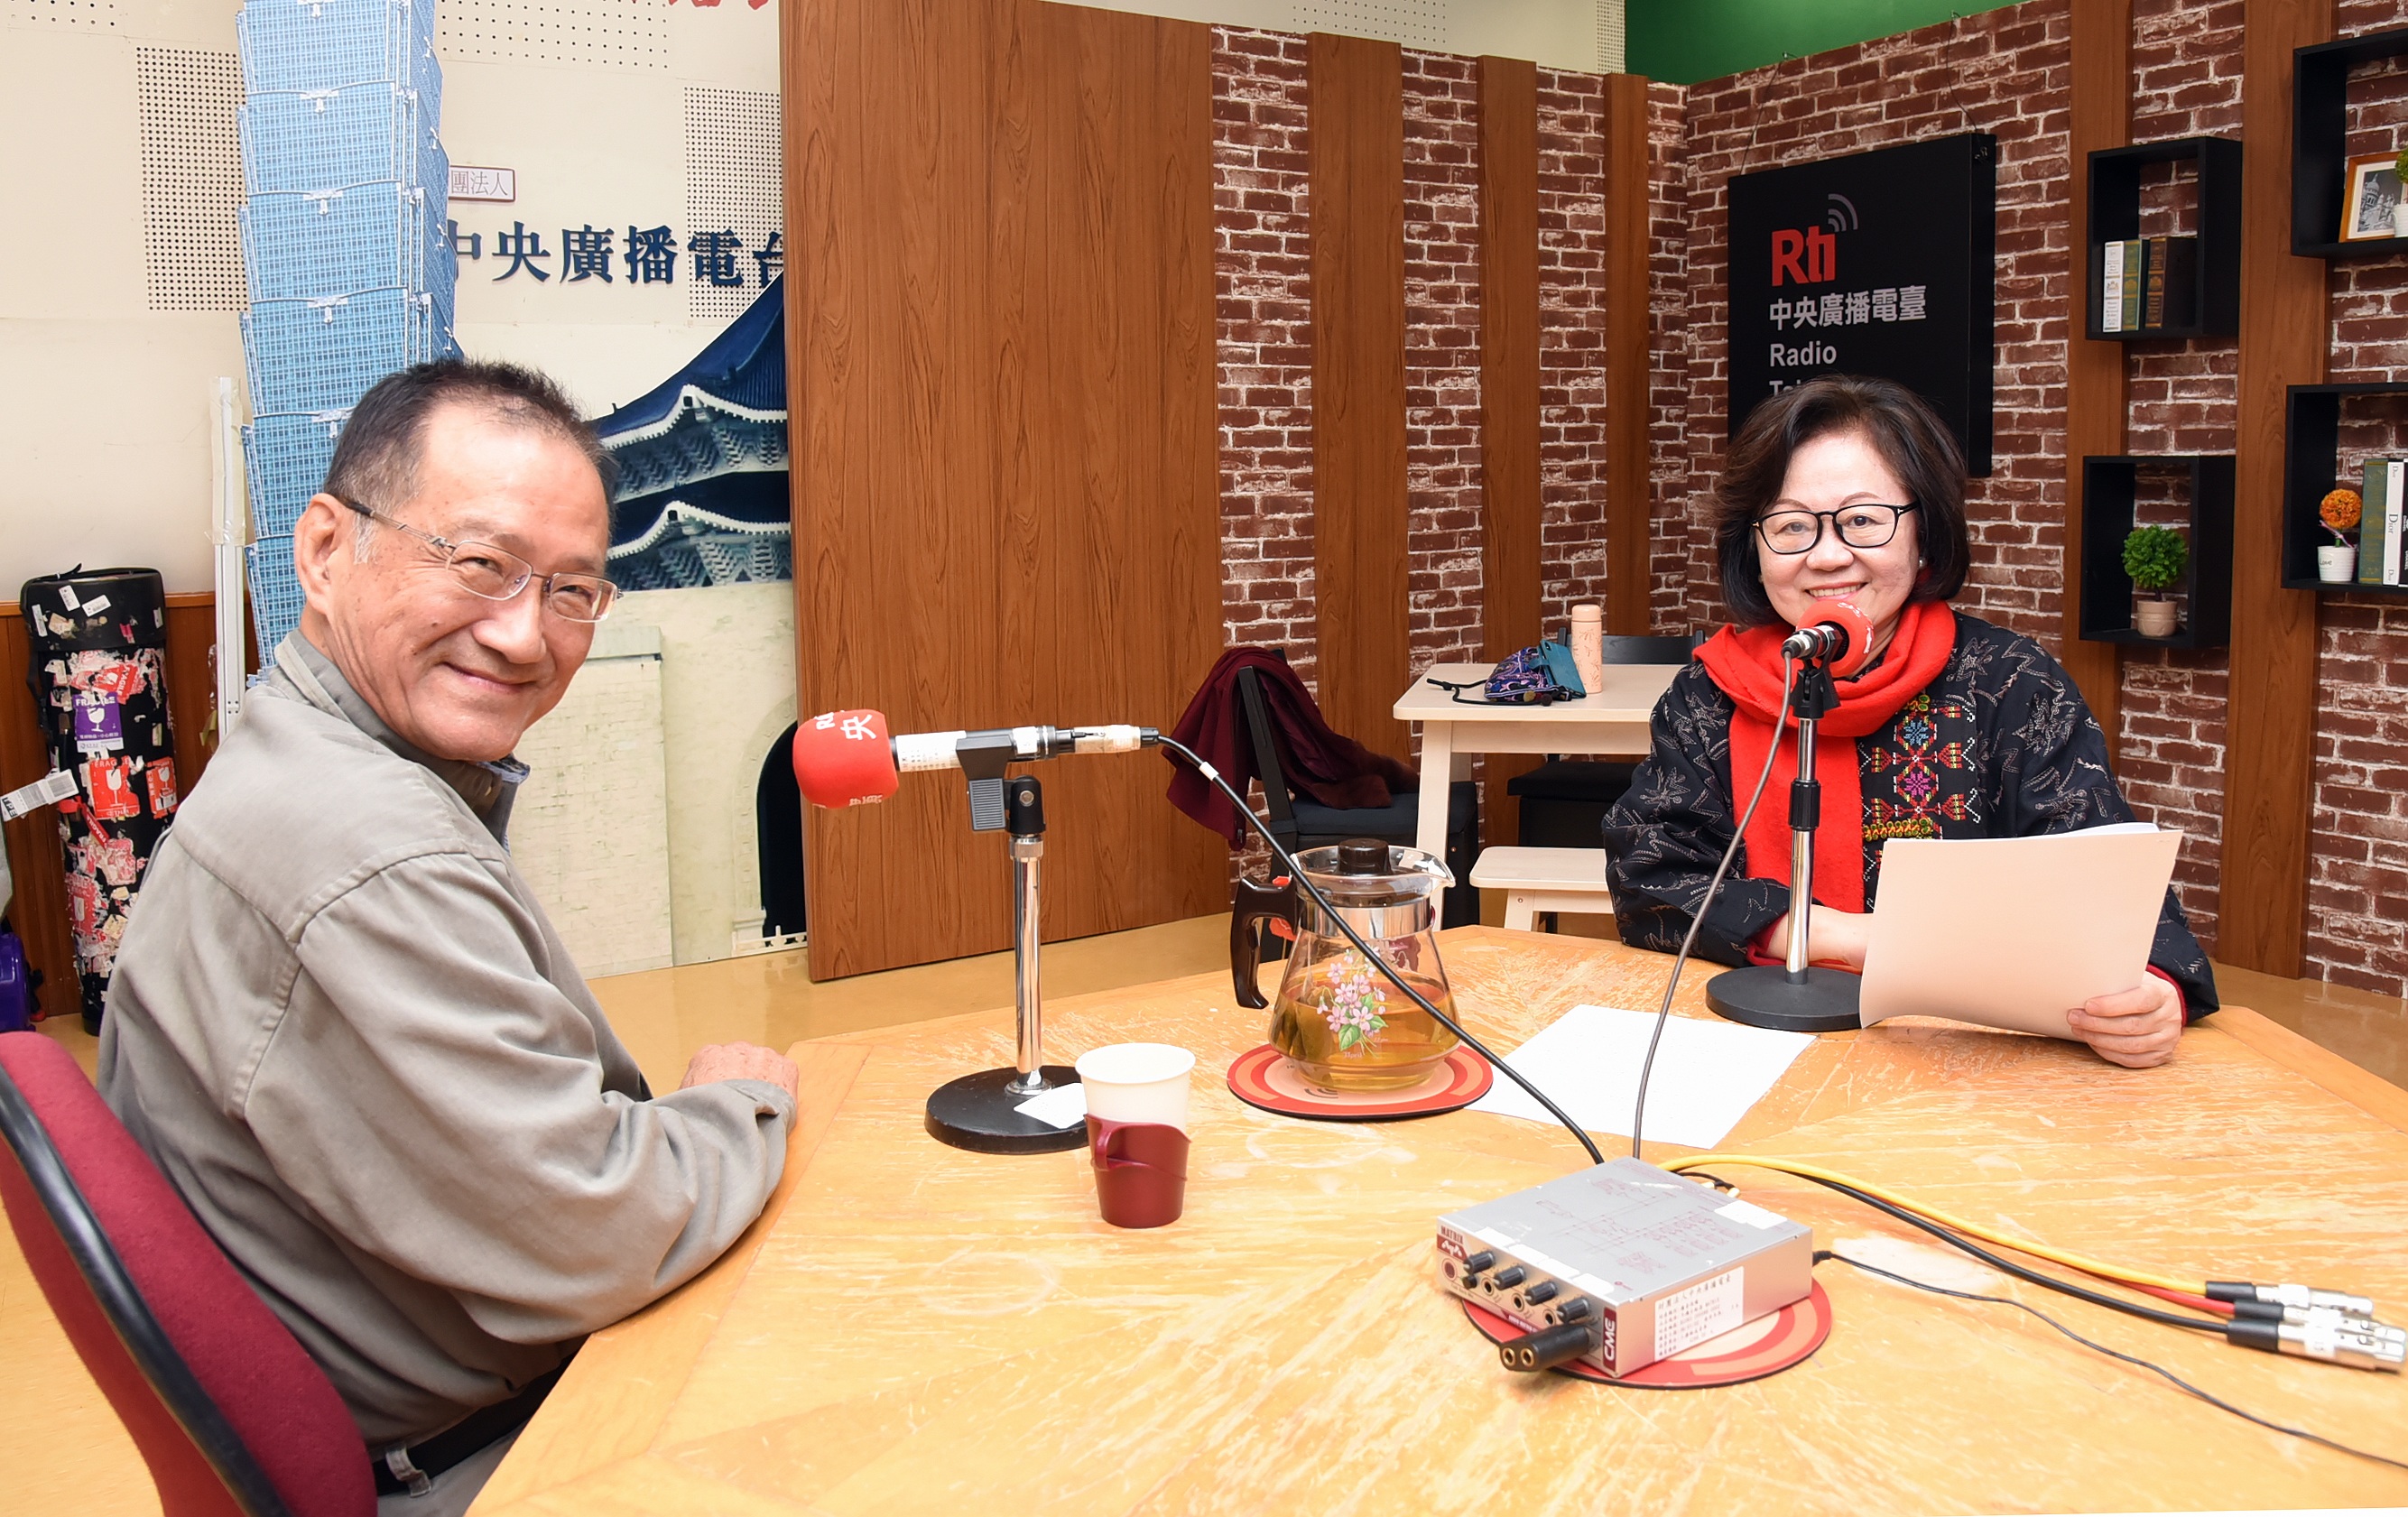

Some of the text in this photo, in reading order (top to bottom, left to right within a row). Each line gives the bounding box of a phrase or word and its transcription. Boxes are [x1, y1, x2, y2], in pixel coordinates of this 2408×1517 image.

[451, 170, 508, 196] 團法人
[1769, 284, 1927, 331] 中央廣播電臺
[1770, 340, 1837, 366] Radio
[1604, 1317, 1616, 1361] CME
